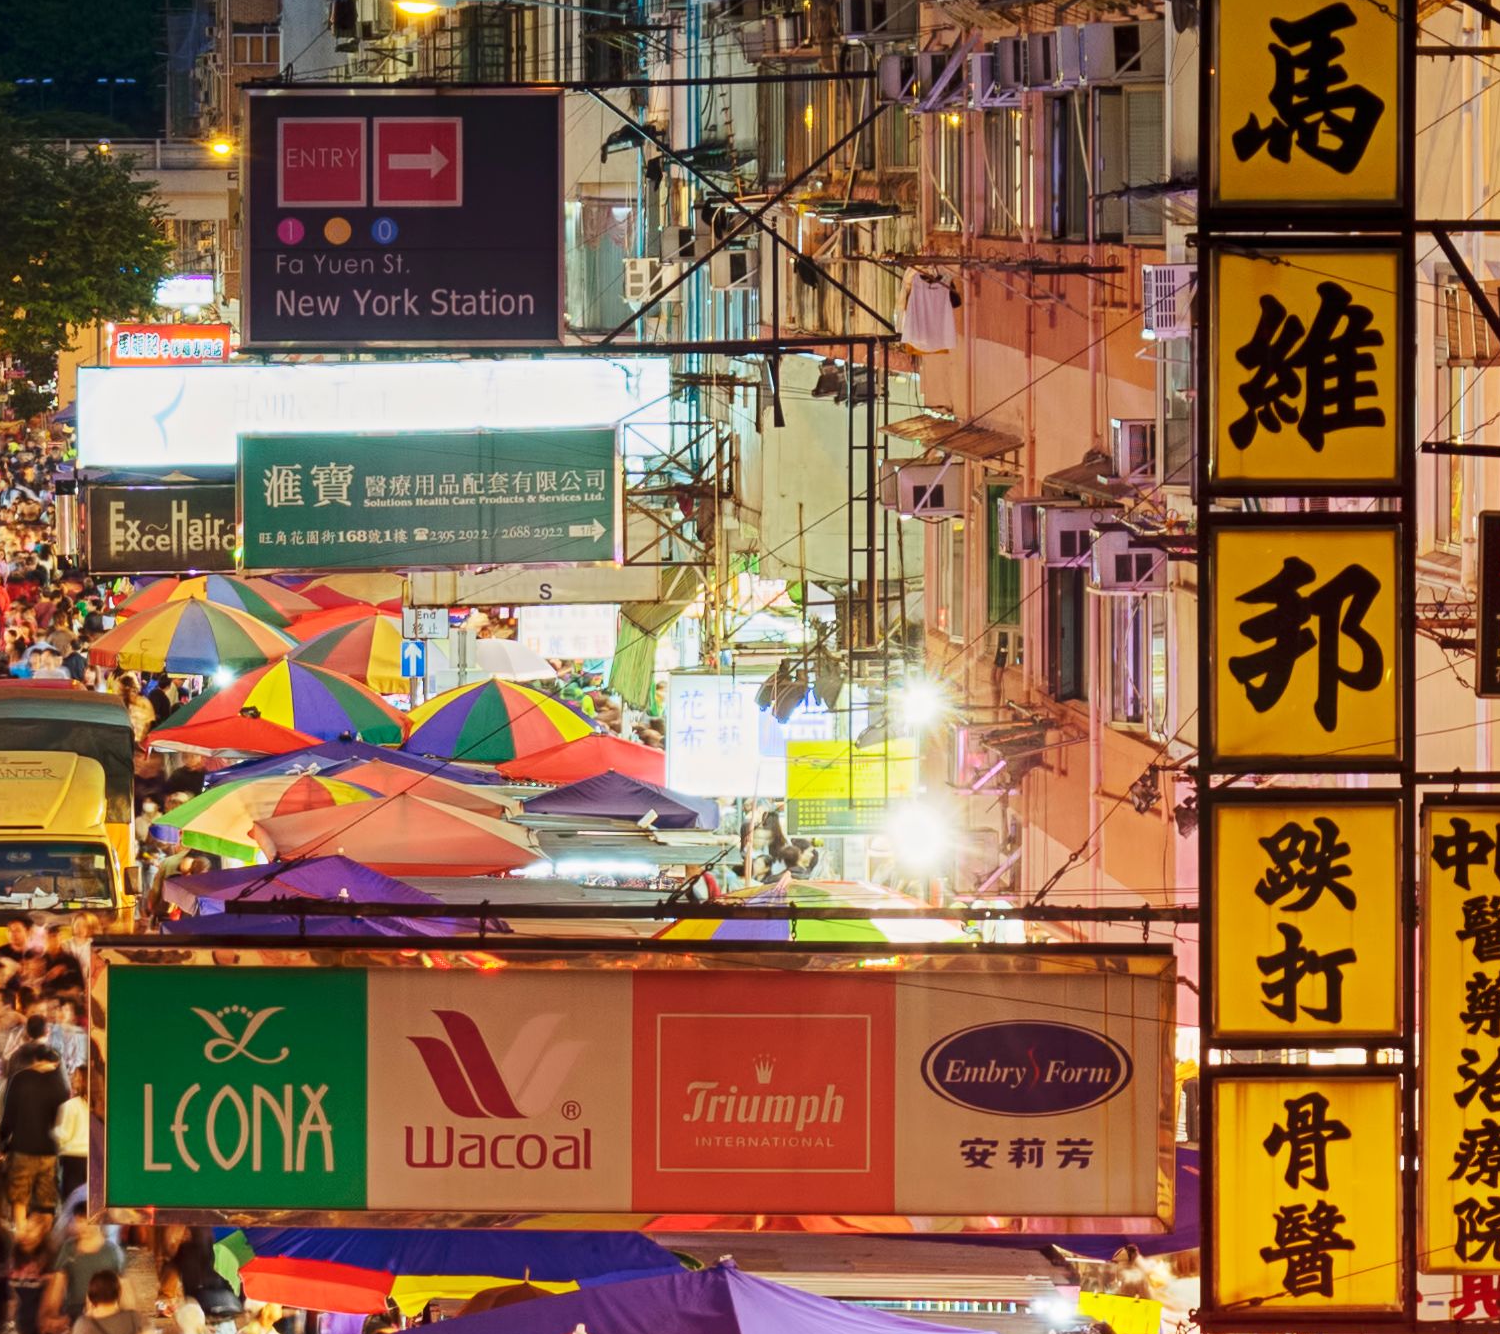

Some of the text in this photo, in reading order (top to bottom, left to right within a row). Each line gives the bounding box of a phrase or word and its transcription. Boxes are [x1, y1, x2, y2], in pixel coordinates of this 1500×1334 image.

[286, 146, 361, 170] ENTRY
[276, 253, 410, 275] Fa Yuen St.
[276, 287, 536, 318] New York Station
[365, 468, 606, 498] 醫療用品配套有限公司
[363, 492, 606, 508] Solutions Health Care Products & Services Ltd.
[428, 530, 456, 545] 2395
[458, 529, 490, 544] 2922
[502, 526, 532, 541] 2688
[534, 525, 565, 540] 2922
[1227, 1, 1386, 1298] 馬維邦 跌打 骨醫
[944, 1052, 1113, 1093] Embry Form
[683, 1078, 846, 1130] Triumph
[143, 1081, 337, 1174] LEONA
[694, 1136, 836, 1149] INTERNATIONAL
[405, 1125, 592, 1172] Wacoal
[959, 1134, 1096, 1171] 安莉芳
